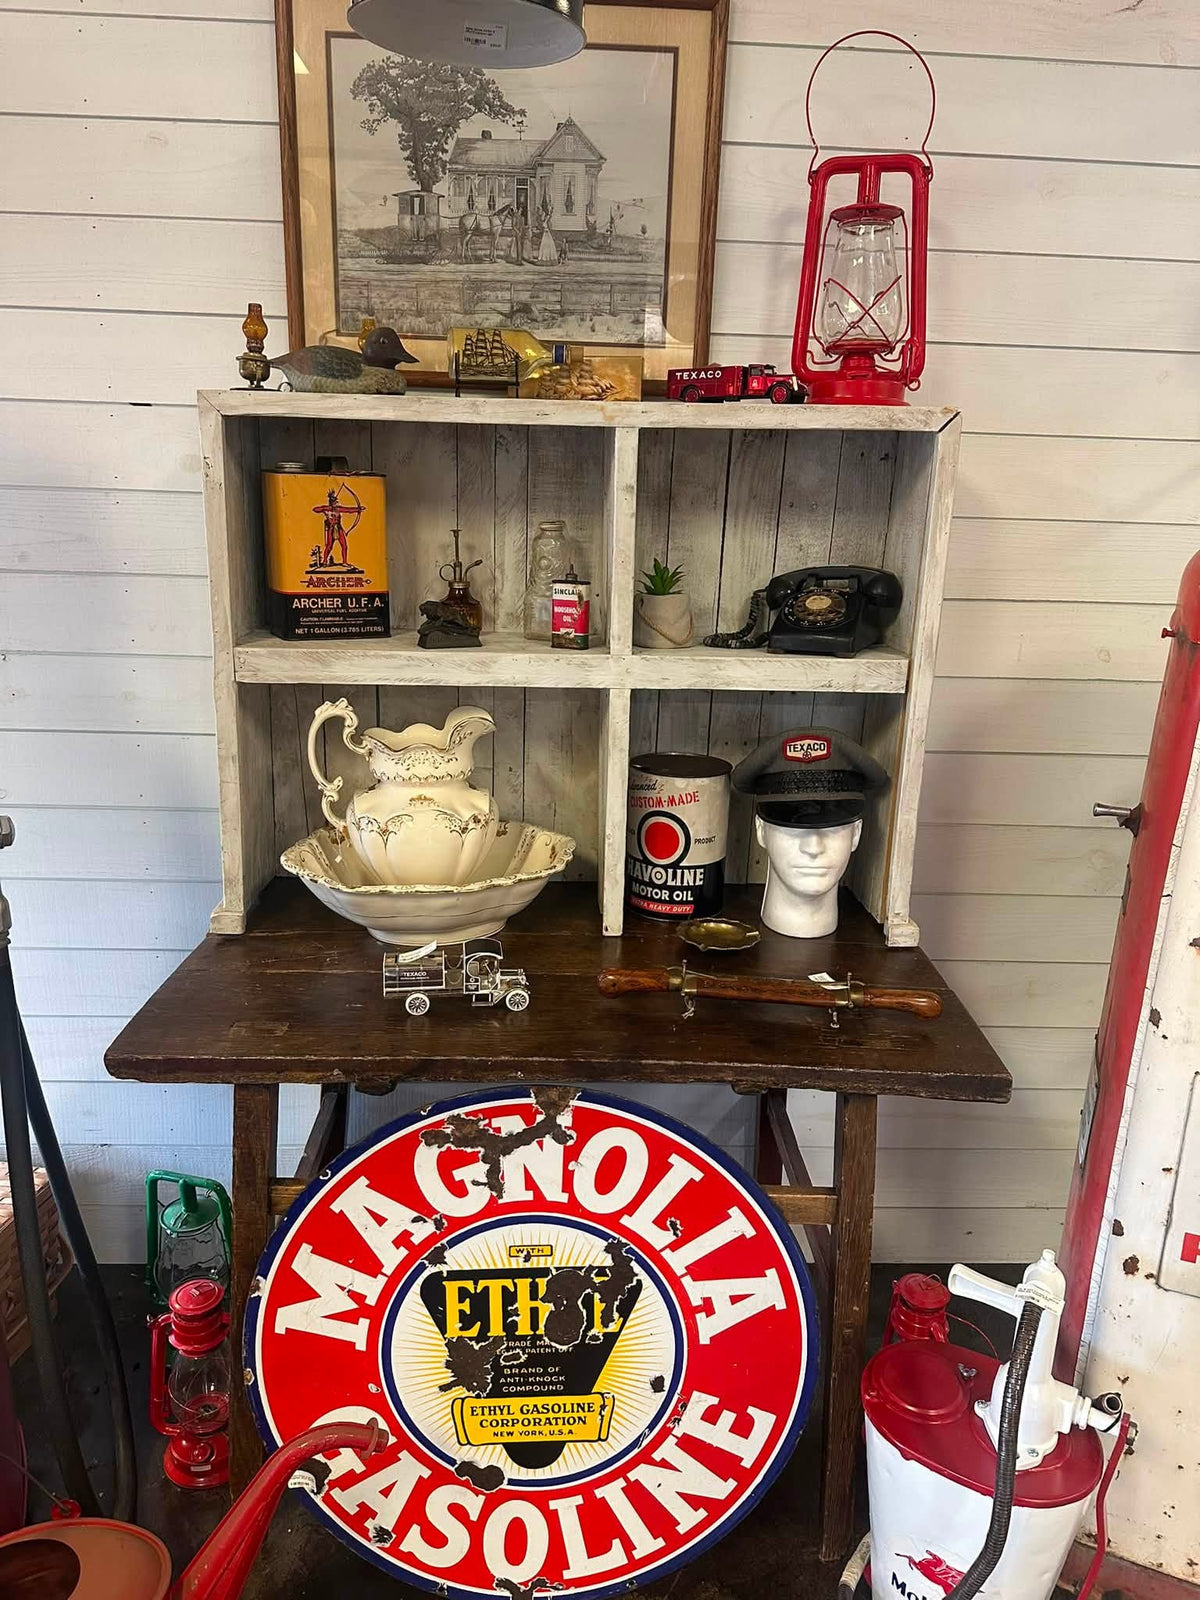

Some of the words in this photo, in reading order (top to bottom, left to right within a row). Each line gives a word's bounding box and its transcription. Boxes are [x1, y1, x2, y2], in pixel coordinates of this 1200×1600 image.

[675, 370, 722, 380] TEXACO
[306, 575, 365, 588] ARCHER
[292, 598, 342, 609] ARCHER
[787, 742, 826, 753] TEXACO
[694, 835, 717, 845] PRODUCT
[627, 857, 704, 887] HAVOLINE
[631, 881, 670, 901] MOTOR
[672, 890, 694, 901] OIL
[648, 904, 671, 912] HEAVY
[274, 1111, 786, 1352] MAGNOLIA
[515, 1247, 545, 1255] WITH
[441, 1274, 624, 1339] ETHL
[503, 1367, 544, 1375] BRAND
[499, 1375, 566, 1383] ANTI-KNOCK
[502, 1384, 565, 1393] COMPOUND
[470, 1404, 515, 1417] ETHYL
[520, 1402, 596, 1415] GASOLINE
[479, 1415, 588, 1428] CORPORATION
[493, 1430, 514, 1438] NEW
